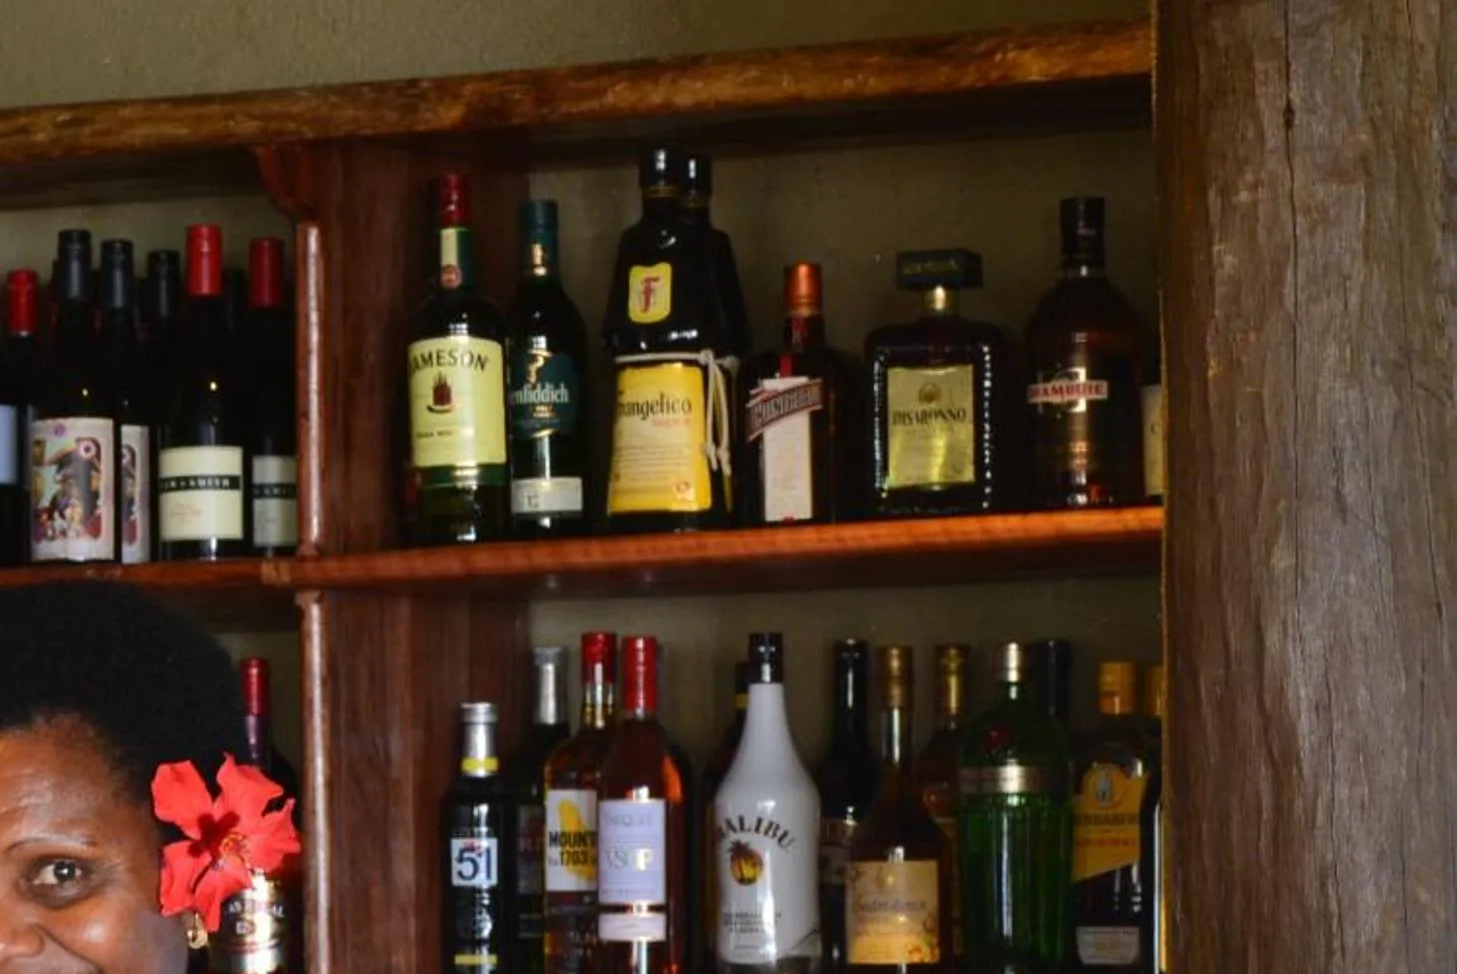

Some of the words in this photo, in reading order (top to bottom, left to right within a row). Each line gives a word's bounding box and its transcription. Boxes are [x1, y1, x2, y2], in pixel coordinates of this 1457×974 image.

[515, 382, 570, 404] nfiddich
[619, 389, 693, 421] angelico
[456, 846, 491, 881] 51
